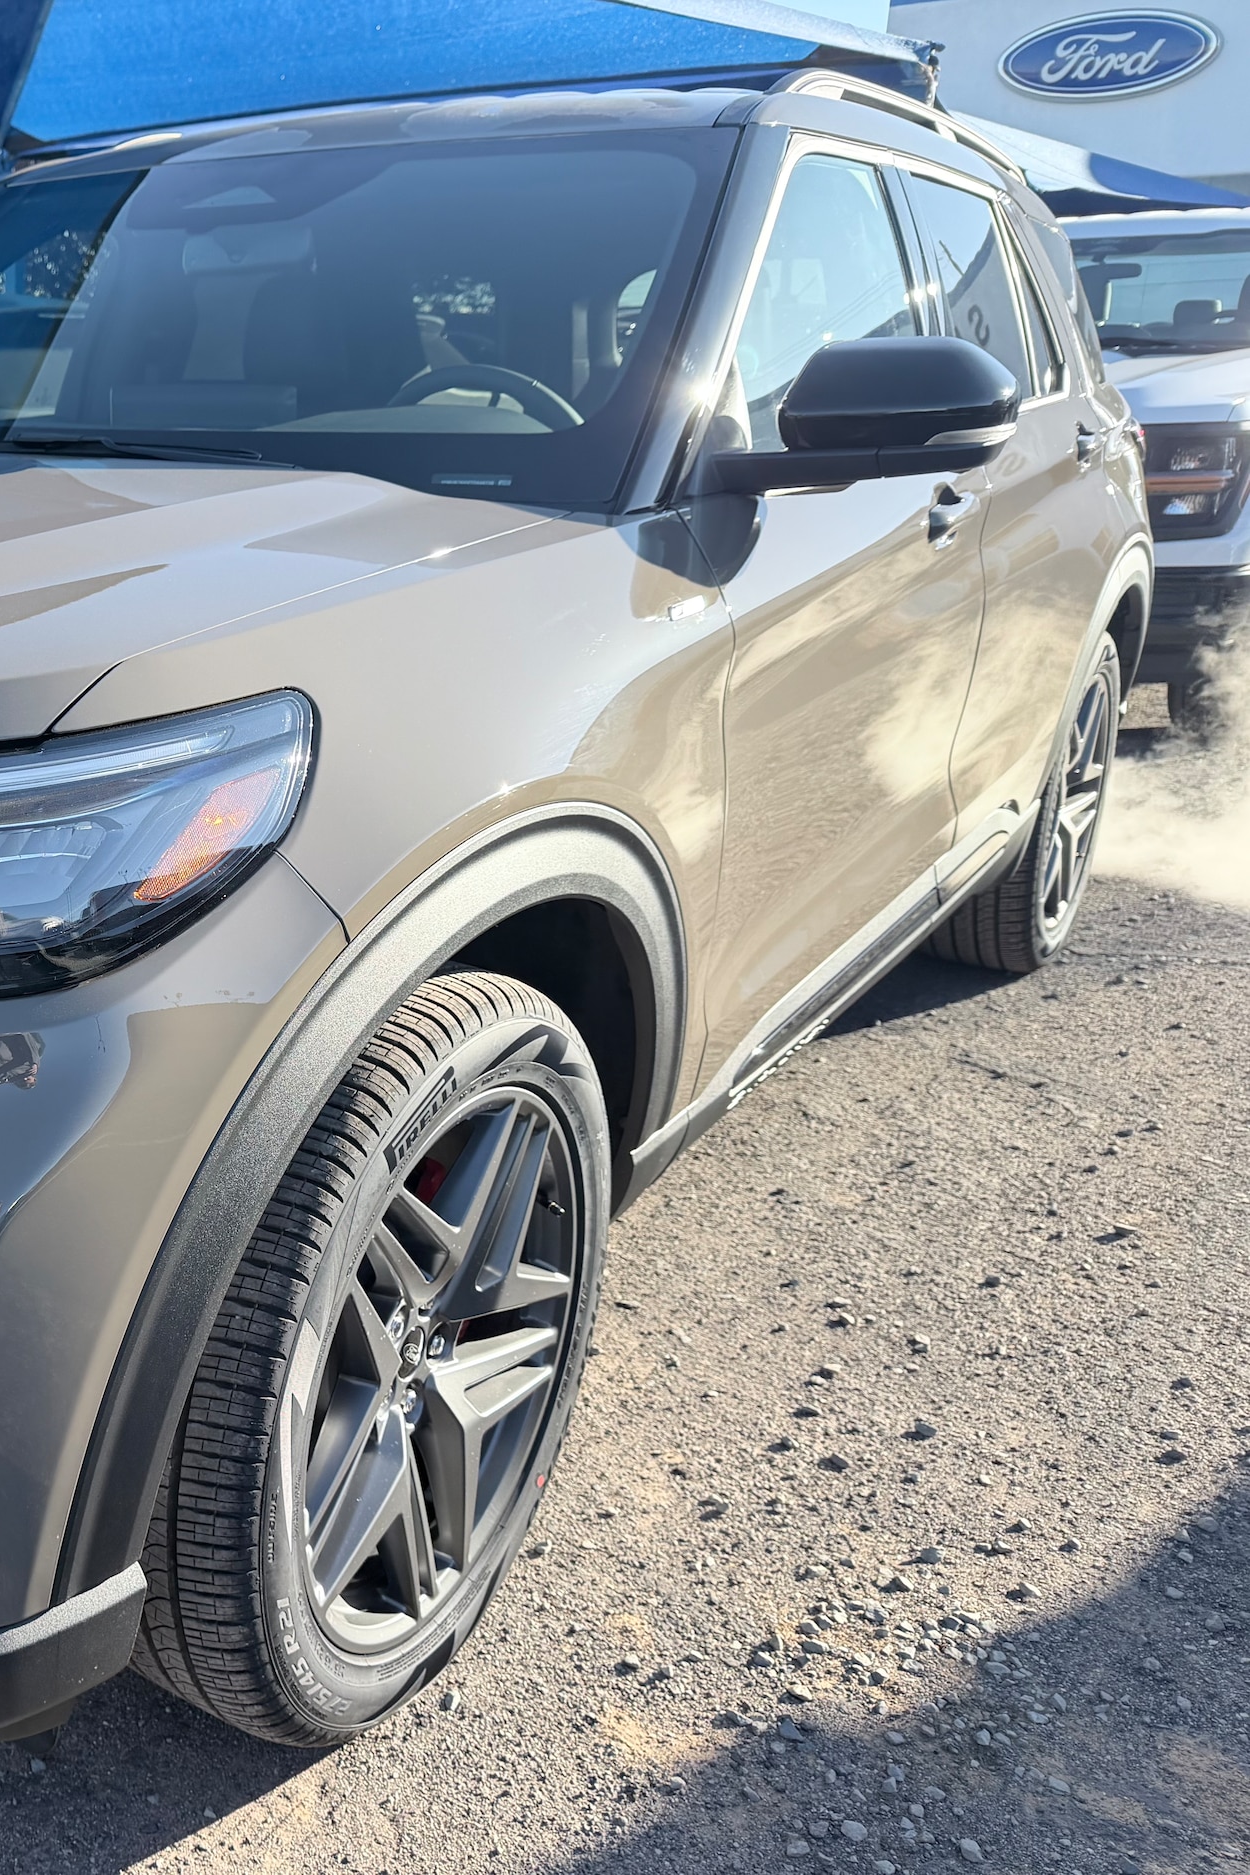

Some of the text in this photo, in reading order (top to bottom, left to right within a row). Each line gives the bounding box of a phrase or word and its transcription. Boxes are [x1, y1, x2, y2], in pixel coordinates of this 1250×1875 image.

[1040, 30, 1167, 84] Ford
[382, 1065, 458, 1176] PIRELLI
[276, 1597, 301, 1655] R21
[291, 1655, 352, 1718] 275/45
